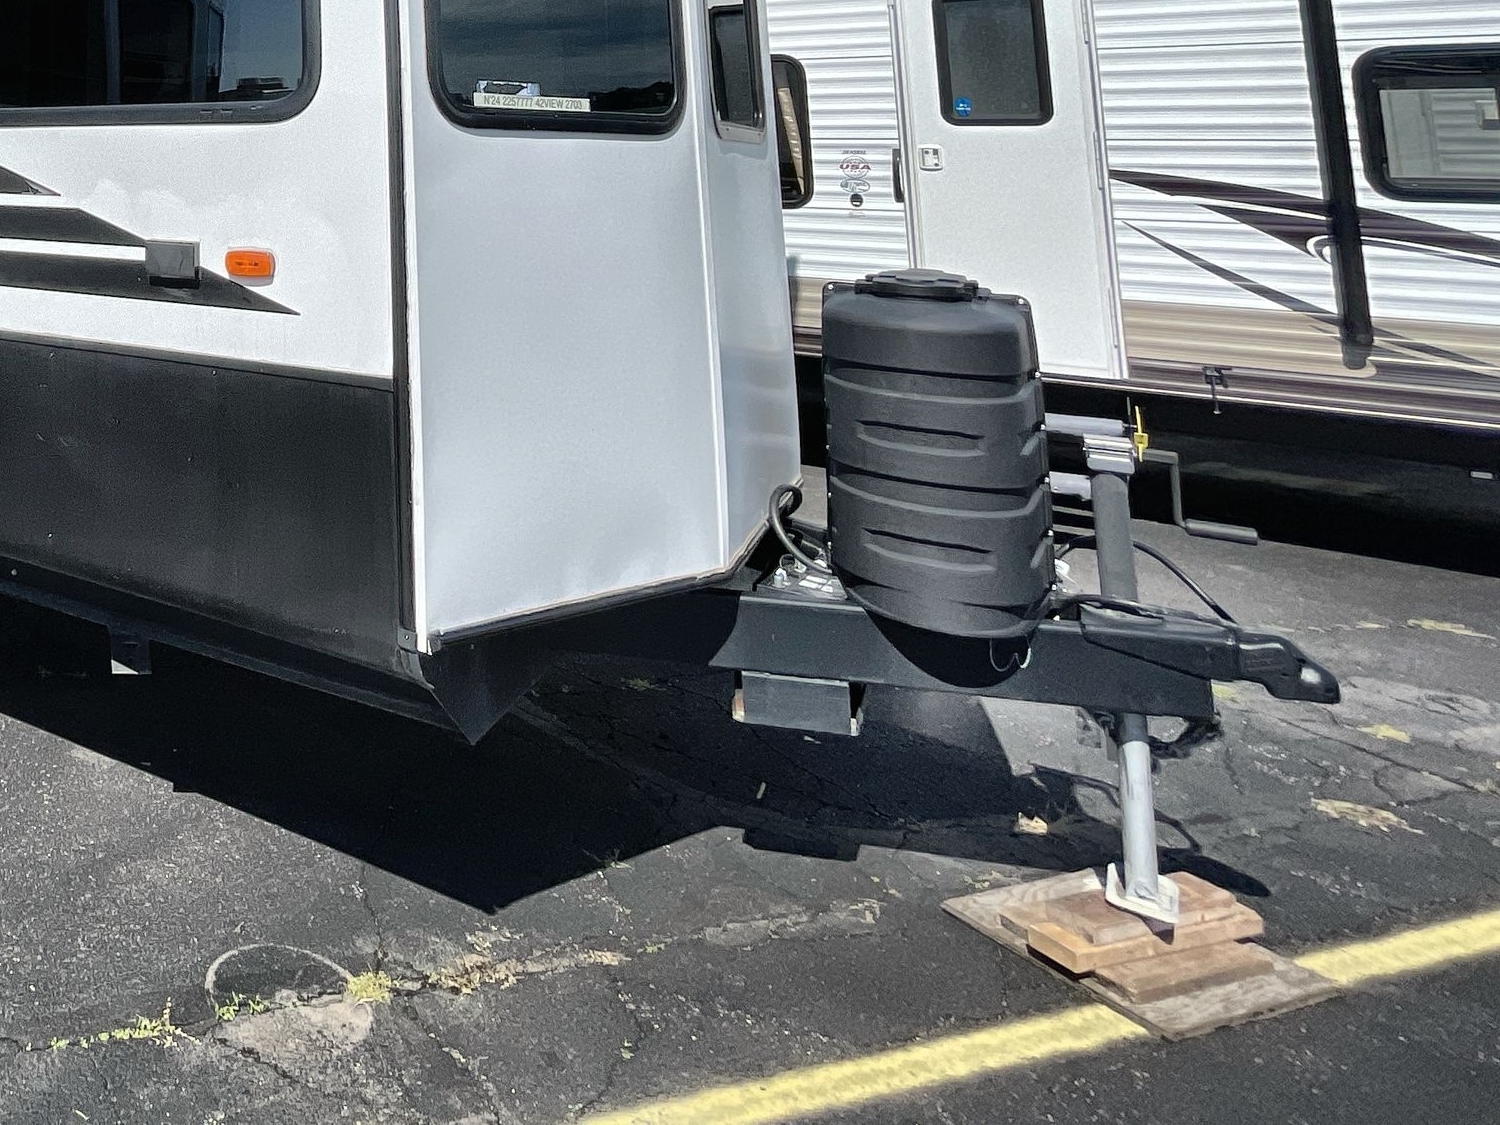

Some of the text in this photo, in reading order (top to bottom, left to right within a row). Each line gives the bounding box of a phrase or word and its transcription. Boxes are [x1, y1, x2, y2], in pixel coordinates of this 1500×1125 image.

[502, 96, 533, 107] 2257777
[535, 98, 563, 108] 42VIEW
[839, 163, 871, 172] USA
